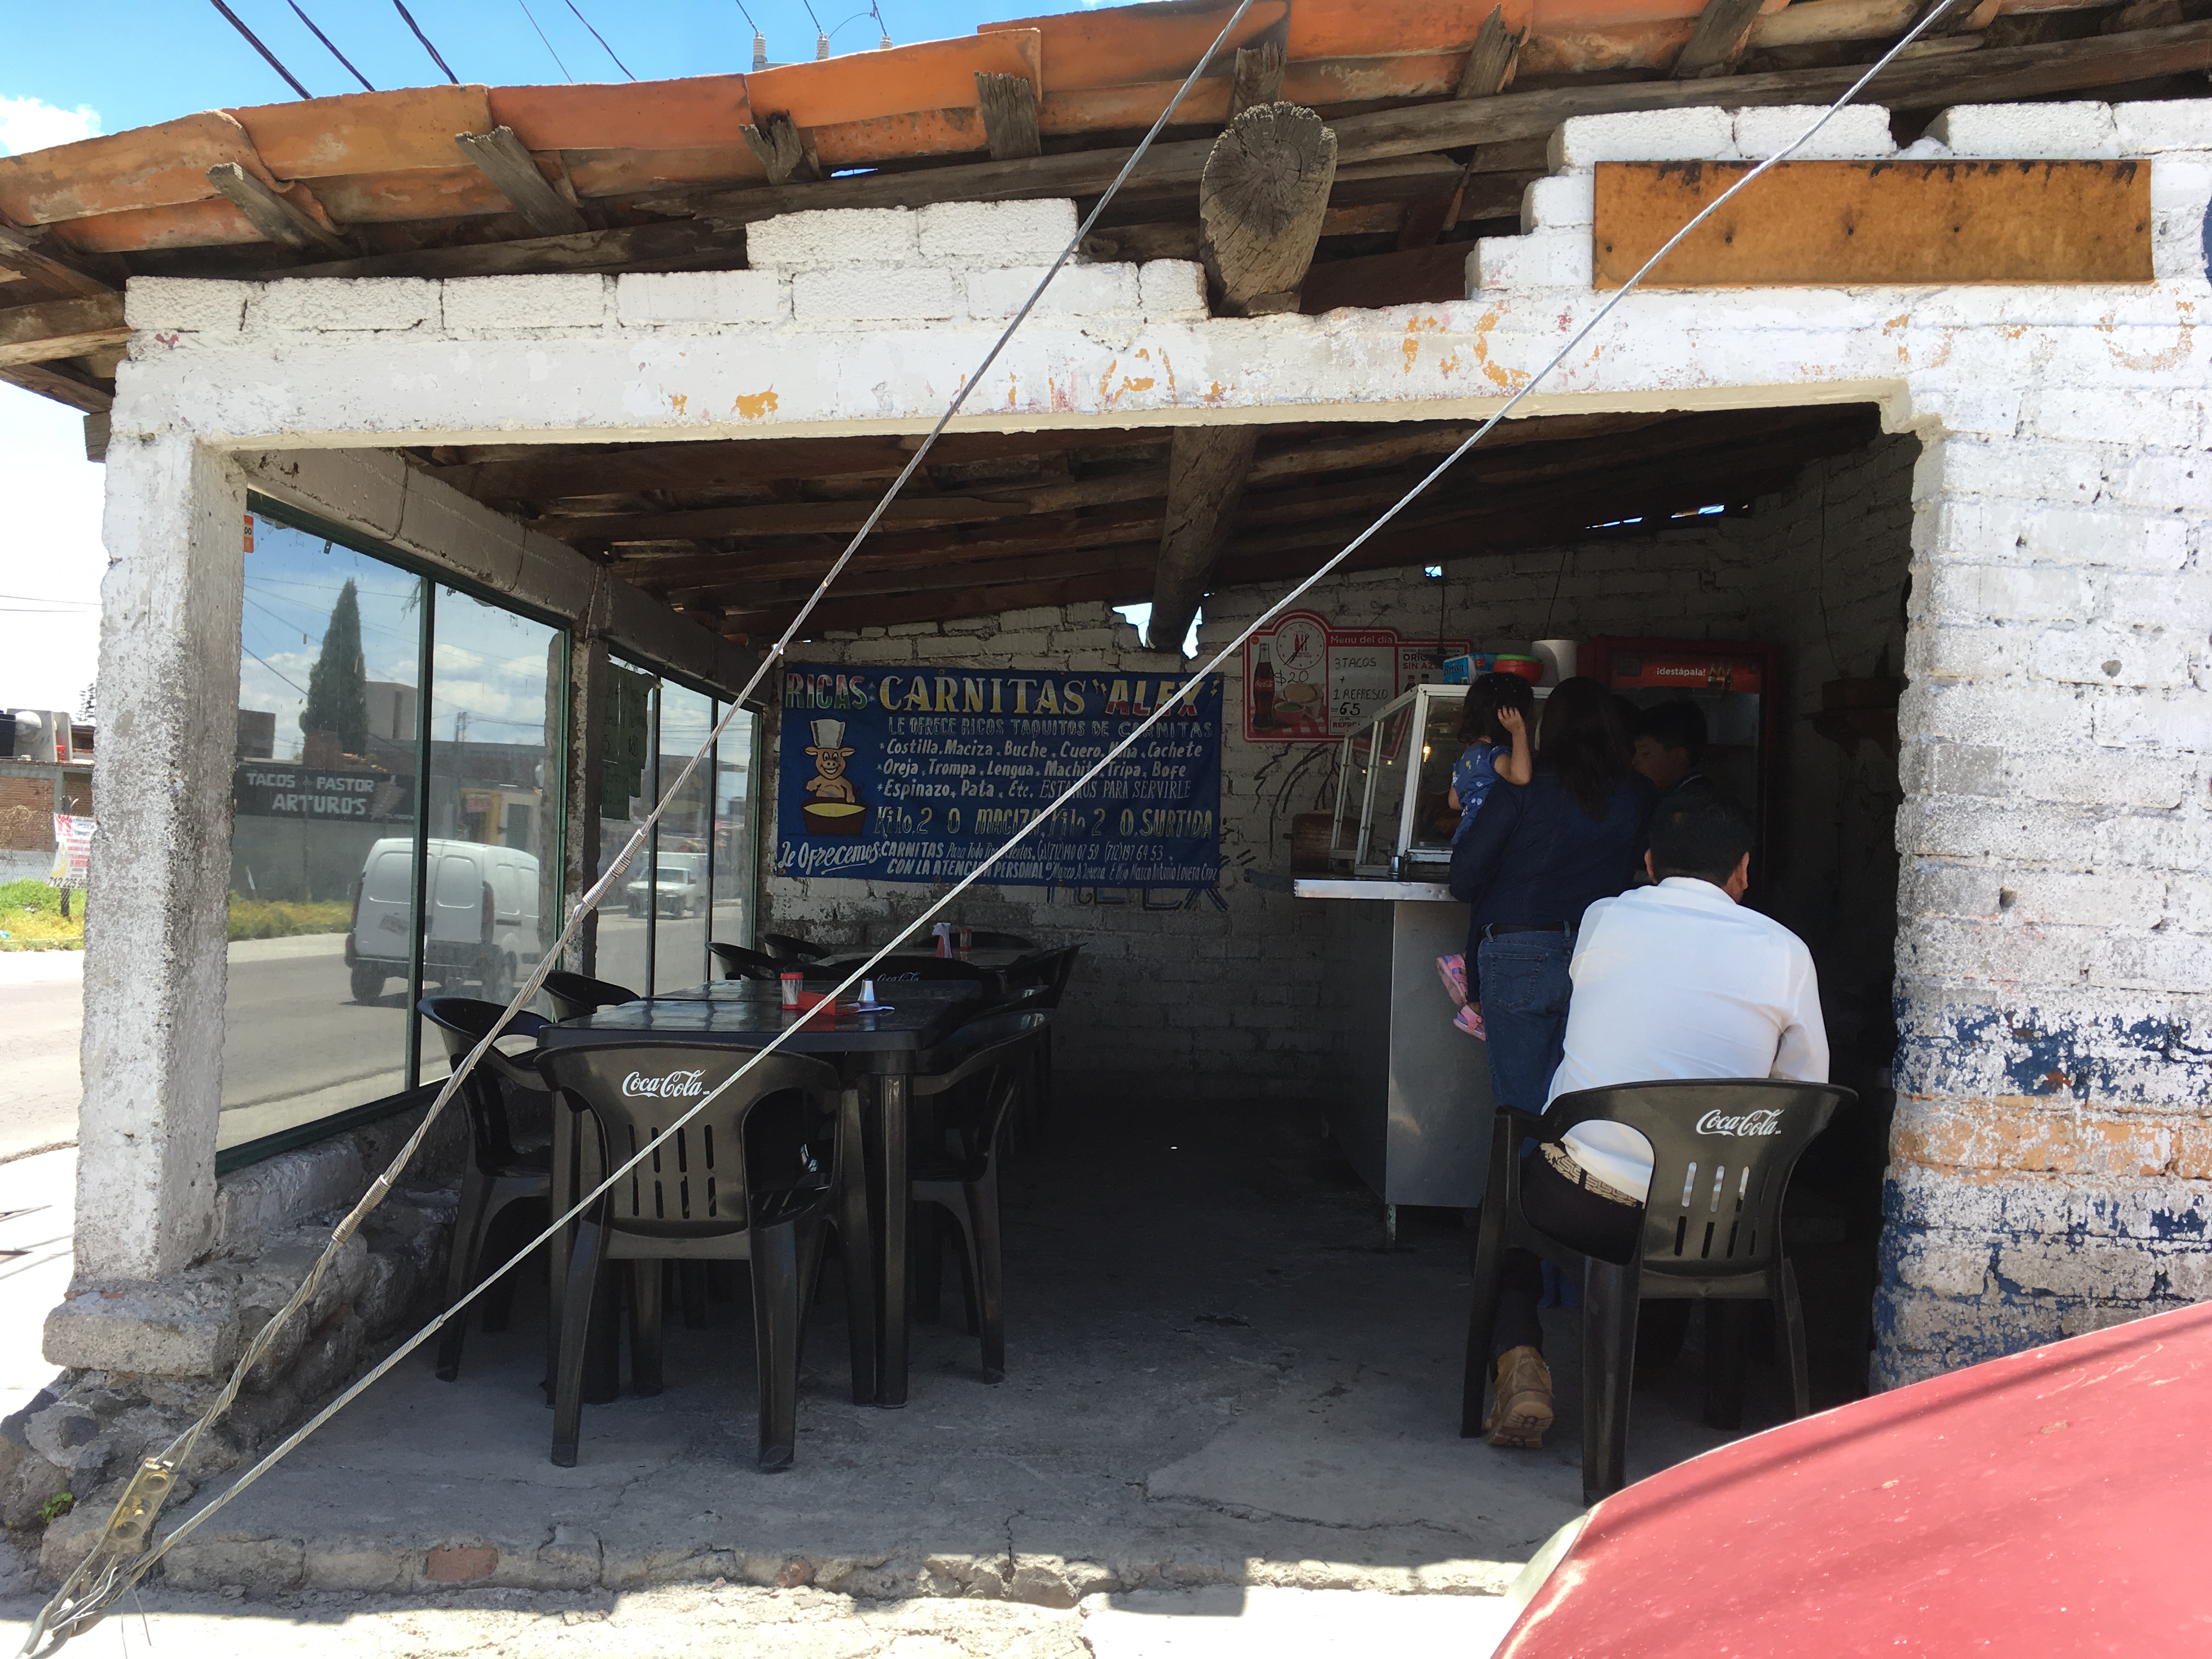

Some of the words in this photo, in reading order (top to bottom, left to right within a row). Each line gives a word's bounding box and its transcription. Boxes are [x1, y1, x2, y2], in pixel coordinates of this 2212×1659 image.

[1359, 635, 1375, 644] del
[1342, 657, 1377, 668] TACOS
[1273, 669, 1309, 686] $20
[785, 673, 868, 710] RICAS
[879, 675, 1087, 715] CARNITAS
[888, 716, 905, 735] LE
[909, 716, 957, 736] OFRECE
[961, 717, 1005, 736] RICOS
[1011, 719, 1086, 738] TAQUITOS
[1092, 720, 1109, 737] DE
[1118, 721, 1213, 738] CARNITAS
[944, 738, 993, 757] Maciza
[1003, 740, 1048, 758] Buche
[1060, 741, 1102, 758] Cuero
[1147, 741, 1203, 758] Cachete
[883, 758, 918, 778] Oreja
[929, 758, 976, 778] Trompa
[986, 759, 1034, 779] Lengua
[1107, 760, 1141, 779] Tripa
[1152, 761, 1187, 780] Bofe
[246, 772, 296, 788] TACOS
[316, 776, 374, 793] PASTOR
[883, 778, 950, 800] Espinazo
[961, 778, 995, 798] Pata
[1102, 780, 1128, 799] PARA
[1132, 780, 1192, 799] SERVIRLE
[974, 808, 1041, 836] MACIZA
[881, 840, 944, 859] CARNITAS
[945, 842, 967, 859] Para
[967, 842, 984, 859] Todo
[1150, 845, 1164, 861] 53
[887, 859, 915, 875] CON
[915, 859, 930, 876] LA
[994, 861, 1044, 879] PERSONAL
[47, 877, 63, 887] 712
[63, 877, 77, 889] 225
[622, 1069, 707, 1098] Coca-Cola
[1696, 1109, 1785, 1137] Coca-Cola
